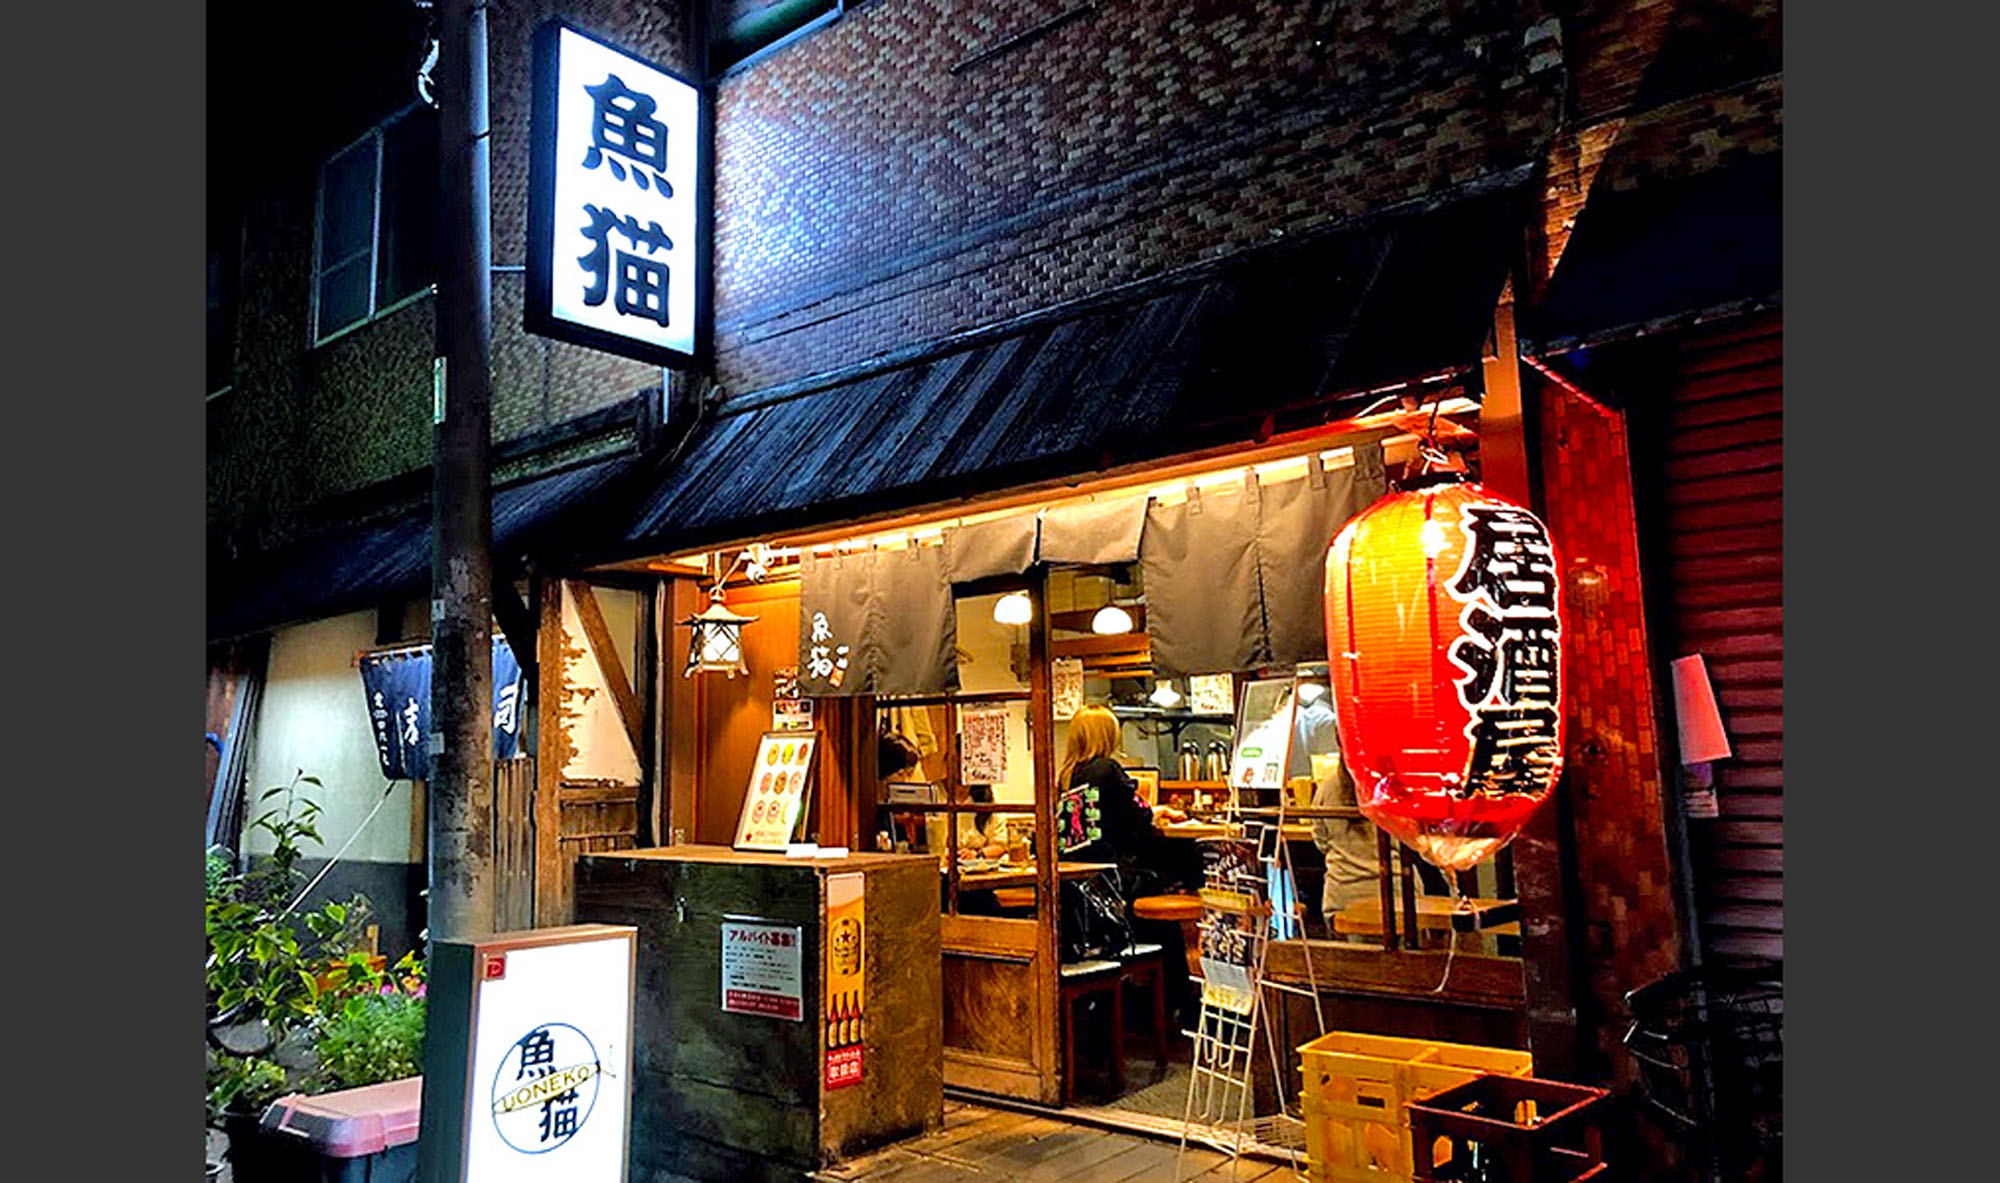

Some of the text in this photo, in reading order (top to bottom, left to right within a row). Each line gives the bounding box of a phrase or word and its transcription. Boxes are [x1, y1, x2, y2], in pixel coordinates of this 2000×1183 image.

[577, 72, 674, 328] 魚猫
[1450, 504, 1561, 800] 居酒屋
[502, 1065, 590, 1112] UONEKO
